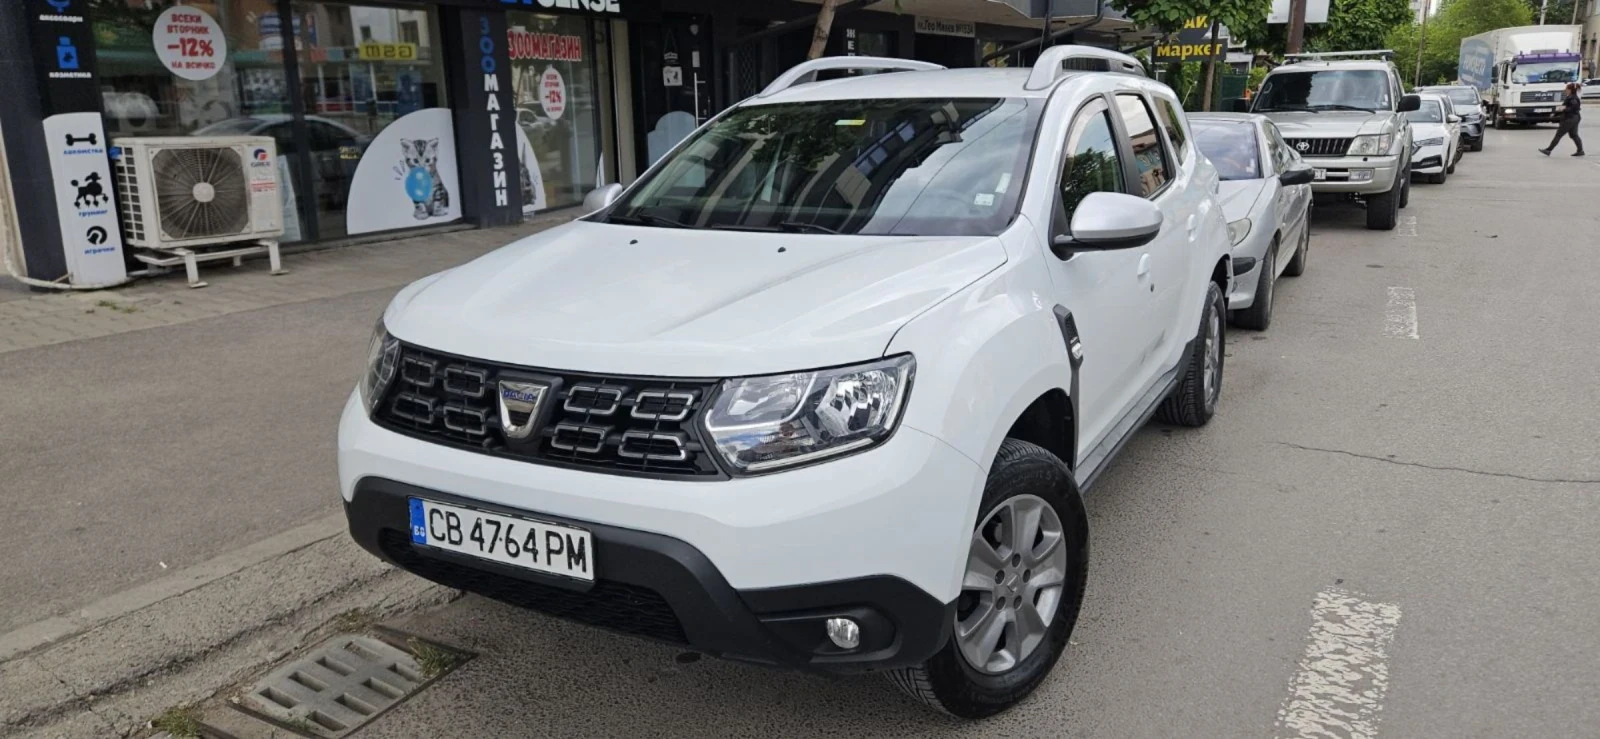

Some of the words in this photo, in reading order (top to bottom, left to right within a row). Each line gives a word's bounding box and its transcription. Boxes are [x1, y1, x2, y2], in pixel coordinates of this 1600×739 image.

[172, 14, 202, 23] ВСЕКИ
[167, 25, 209, 34] ВТОРНИК
[167, 38, 214, 57] -12%
[507, 29, 582, 62] ЗООМАГАЗИН
[1156, 44, 1223, 60] маркет
[479, 16, 508, 207] ЗООМАГАЗИН
[503, 389, 536, 402] DACIA
[470, 517, 539, 563] 4764
